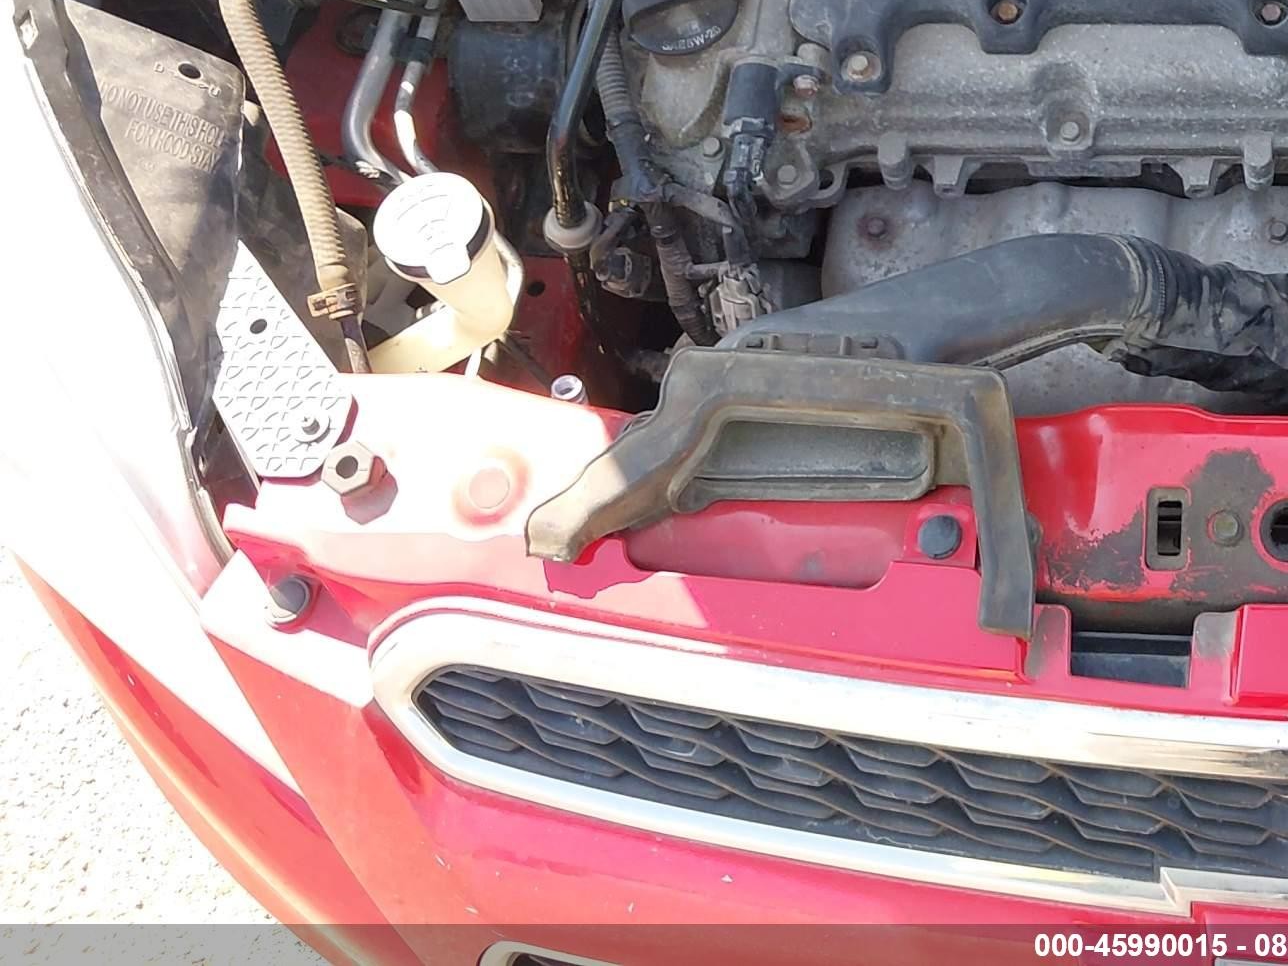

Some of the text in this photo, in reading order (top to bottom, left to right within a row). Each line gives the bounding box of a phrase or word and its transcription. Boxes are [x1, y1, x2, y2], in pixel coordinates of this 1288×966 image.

[118, 87, 144, 111] NOT
[144, 96, 173, 126] USE
[169, 108, 199, 137] THIS
[125, 117, 221, 173] FOR HOOD STAY
